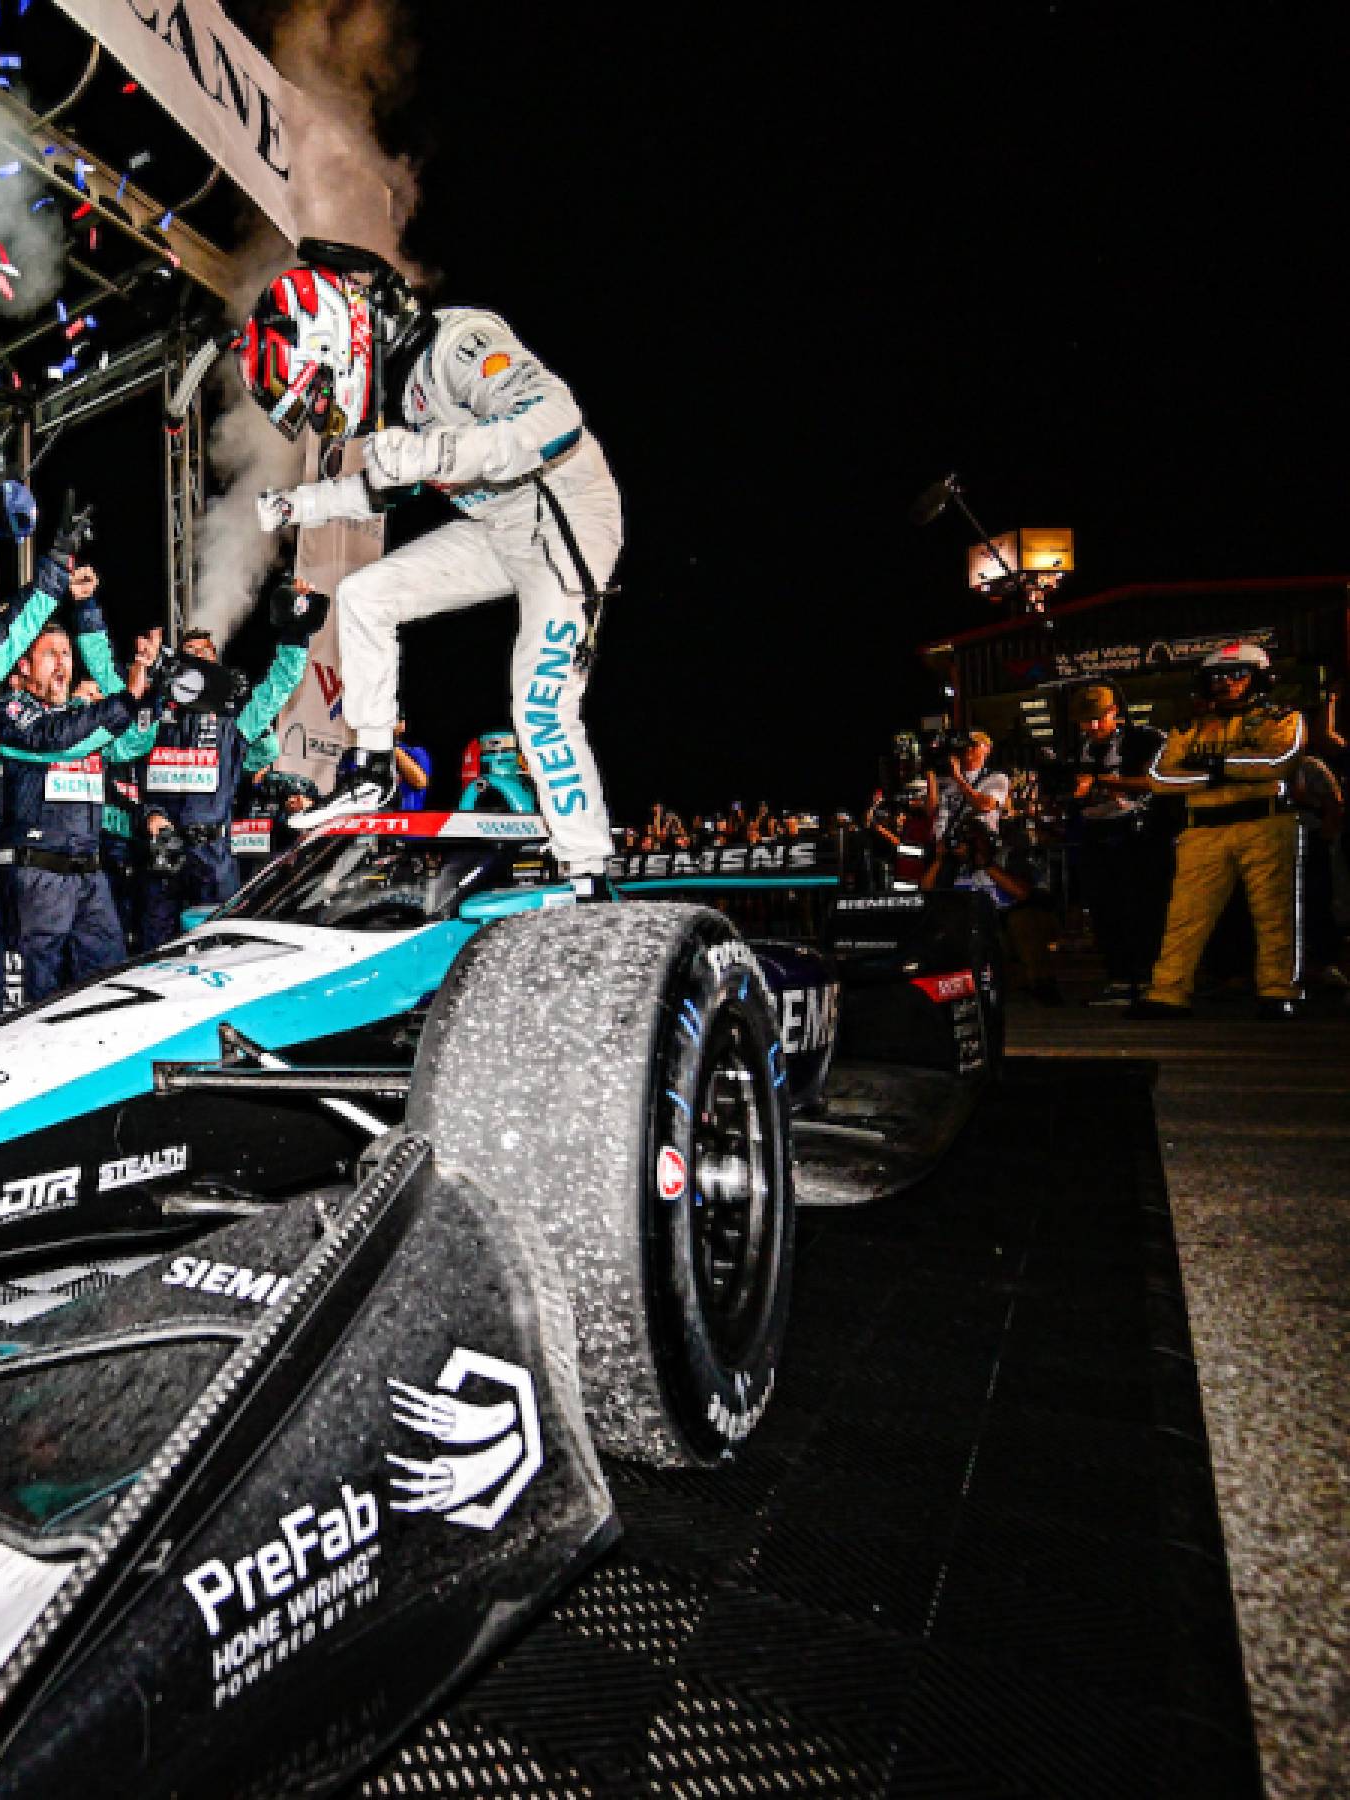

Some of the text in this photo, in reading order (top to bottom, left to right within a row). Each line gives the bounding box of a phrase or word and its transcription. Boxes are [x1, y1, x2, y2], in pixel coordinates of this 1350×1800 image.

[525, 618, 588, 817] SIEMENS
[97, 1144, 188, 1193] STEALTH
[183, 1484, 379, 1636] PreFab
